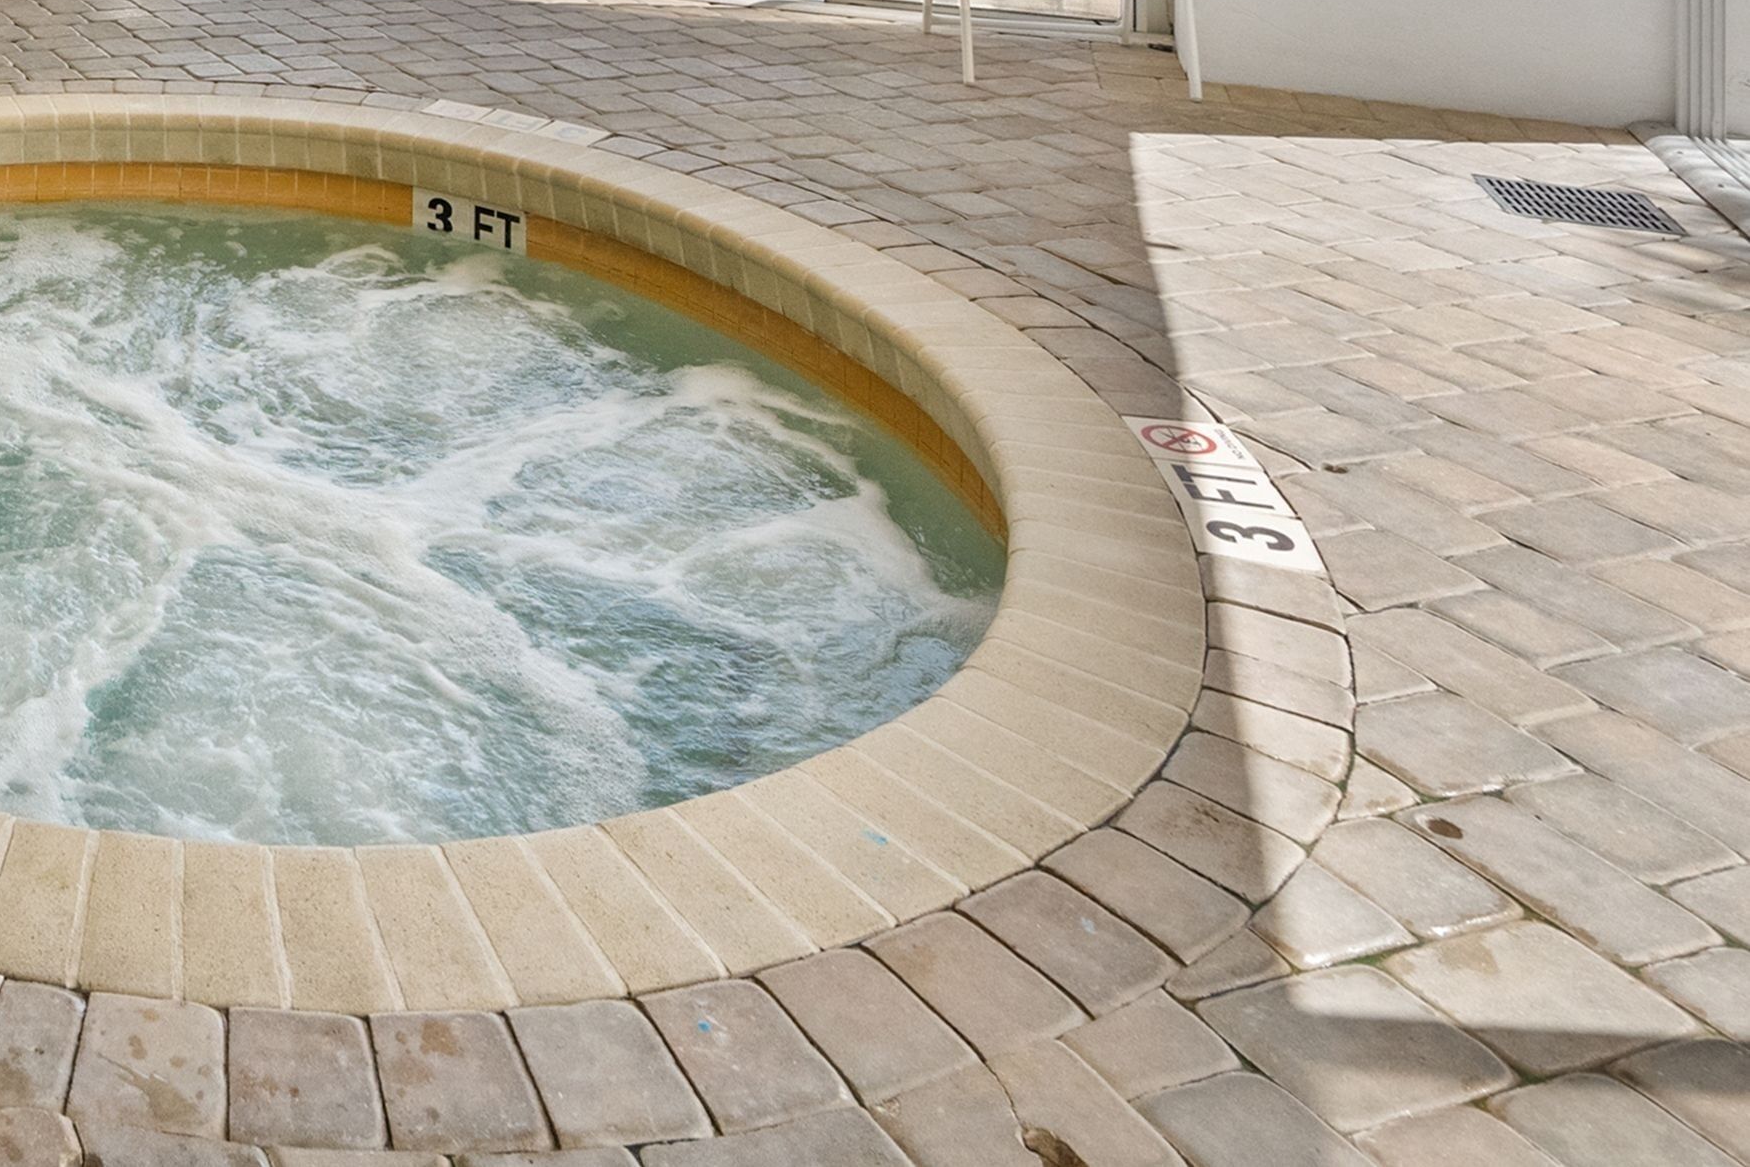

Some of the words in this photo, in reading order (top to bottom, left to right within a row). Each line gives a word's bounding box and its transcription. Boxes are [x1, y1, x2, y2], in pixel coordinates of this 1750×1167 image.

[427, 197, 453, 233] 3
[474, 205, 521, 249] FT
[1171, 464, 1276, 510] FT
[1206, 520, 1296, 552] 3
